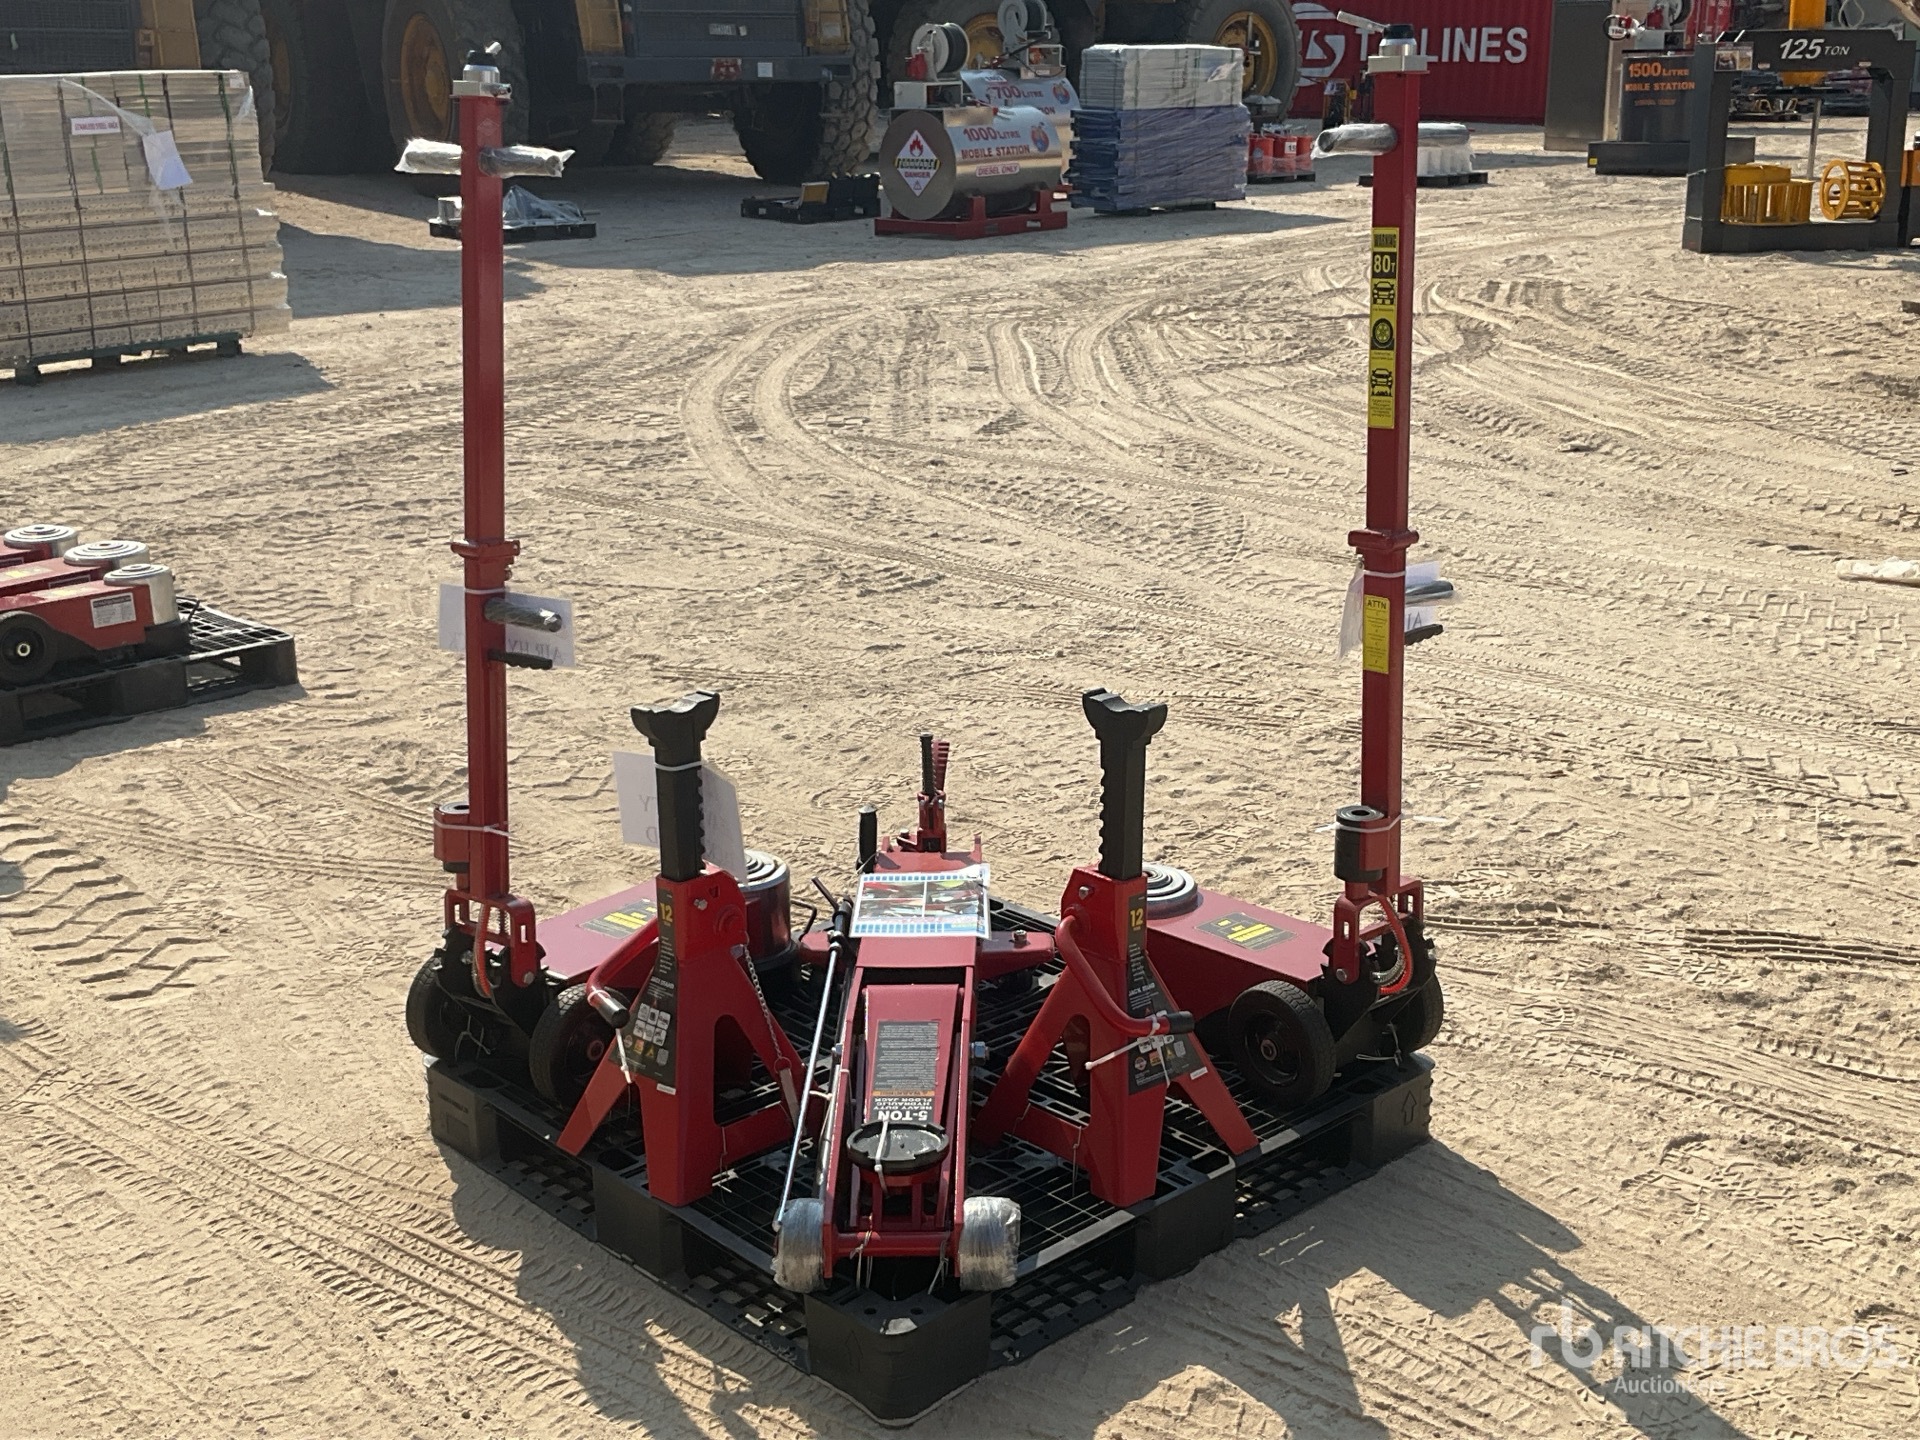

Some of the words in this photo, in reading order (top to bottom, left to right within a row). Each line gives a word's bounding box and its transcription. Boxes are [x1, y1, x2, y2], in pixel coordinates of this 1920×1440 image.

[1421, 27, 1528, 64] LINES
[1779, 38, 1824, 60] 125
[1824, 46, 1851, 57] TON
[1629, 62, 1662, 77] 1500
[1663, 68, 1689, 76] LITRE
[996, 86, 1021, 98] 700
[1022, 90, 1044, 98] LITRE
[1653, 82, 1695, 91] STATION
[963, 126, 997, 142] 1000
[997, 131, 1021, 140] LITRE
[961, 149, 993, 159] MOBILE
[996, 144, 1031, 157] STATION
[978, 166, 999, 176] DIESEL
[1001, 165, 1018, 175] ONLY
[1367, 599, 1387, 609] ATTN
[660, 903, 673, 922] 12
[1130, 908, 1144, 926] 12
[878, 1110, 929, 1121] 5-TON
